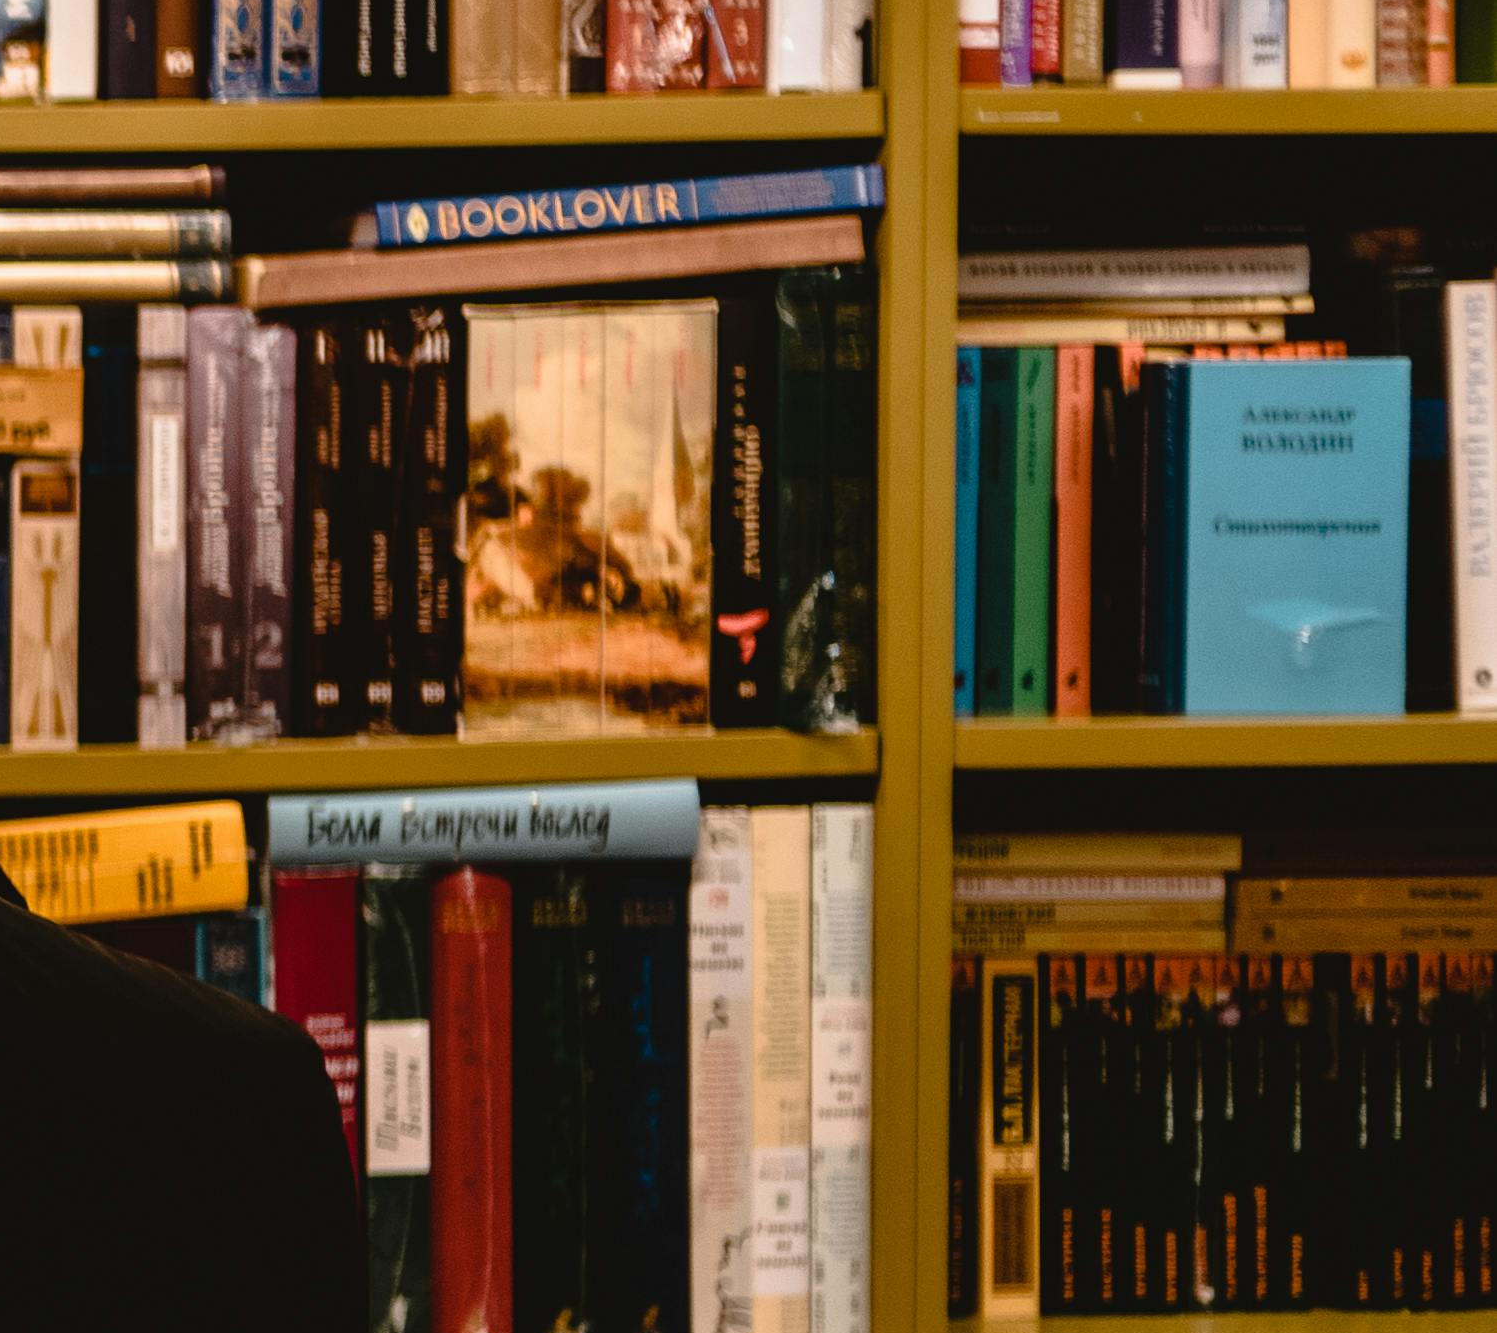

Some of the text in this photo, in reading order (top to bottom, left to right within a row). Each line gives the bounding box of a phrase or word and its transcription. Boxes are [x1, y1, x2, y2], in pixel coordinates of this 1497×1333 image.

[437, 183, 682, 241] BOOKLOVER
[1241, 432, 1354, 455] ВОЛОДИН
[1465, 293, 1491, 578] ВАЛЕРИЙ БРЮСОВ
